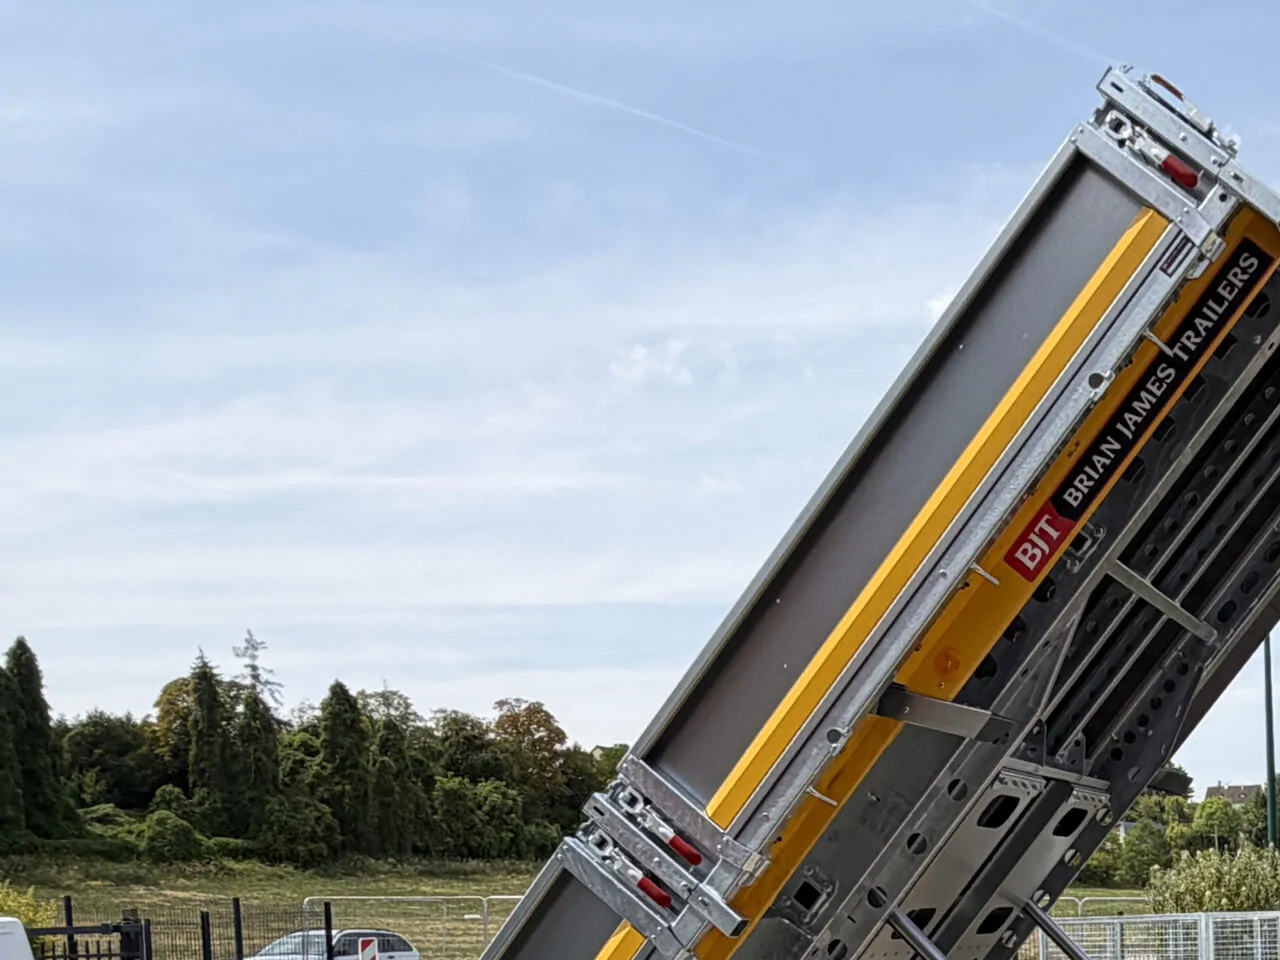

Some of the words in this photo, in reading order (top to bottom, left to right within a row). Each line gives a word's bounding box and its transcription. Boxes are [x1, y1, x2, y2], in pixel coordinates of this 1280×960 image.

[1014, 512, 1062, 571] BJT
[1062, 436, 1122, 508] BRIAN
[1120, 363, 1176, 441] JAMES
[1174, 252, 1259, 362] TRAILERS
